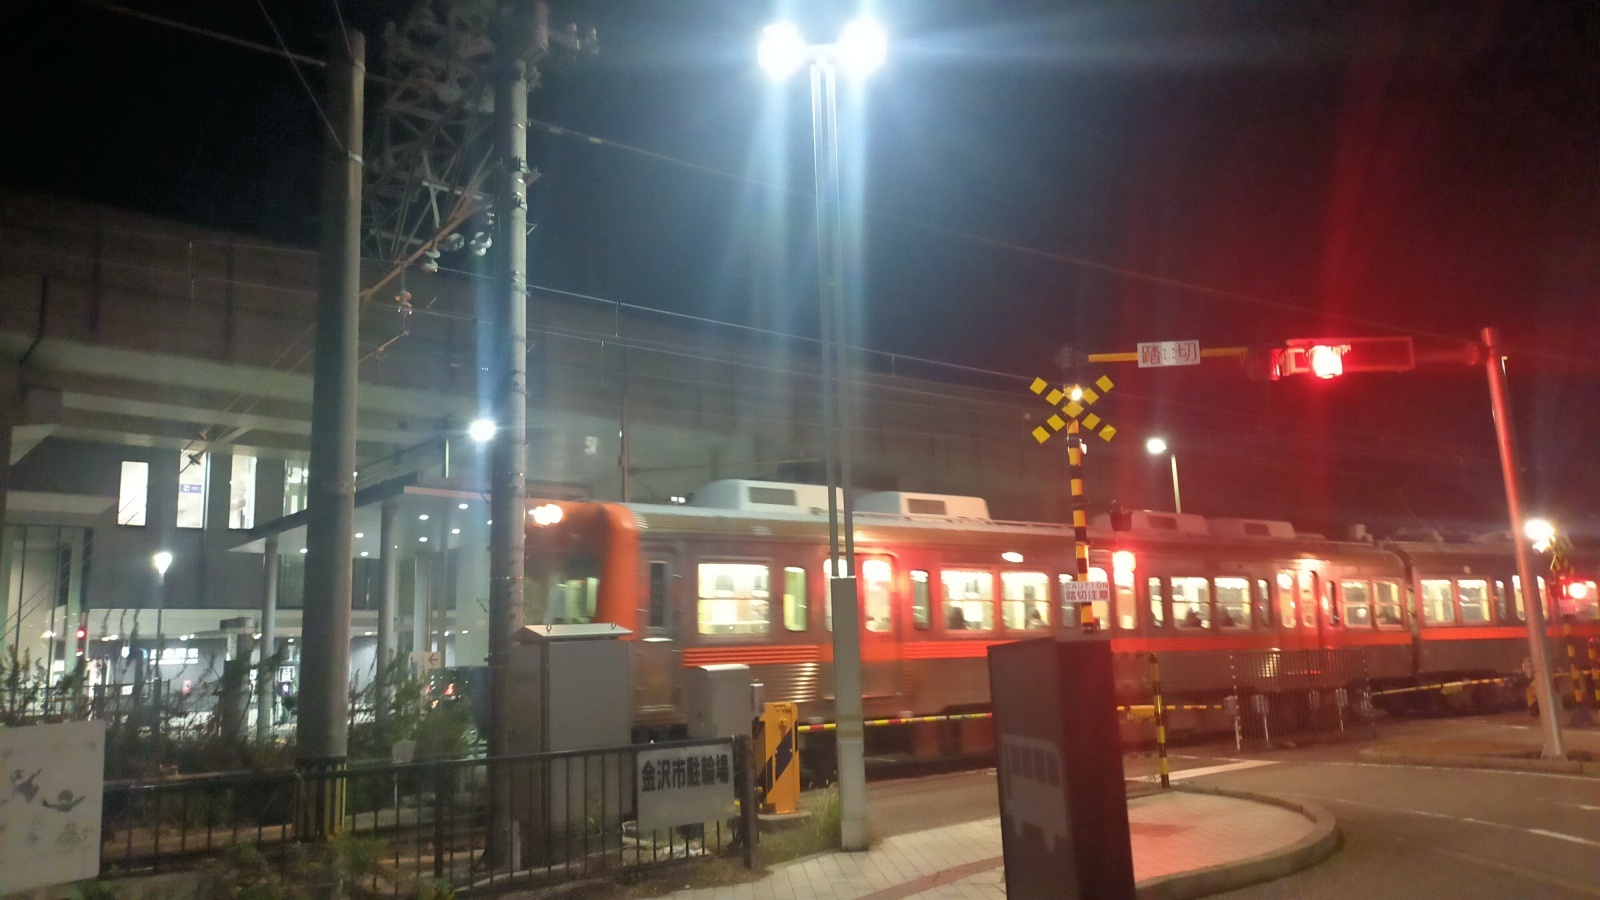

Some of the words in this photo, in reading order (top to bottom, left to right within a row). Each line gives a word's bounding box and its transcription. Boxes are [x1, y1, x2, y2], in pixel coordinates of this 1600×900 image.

[1141, 342, 1197, 364] 踏切
[1065, 582, 1109, 590] CAUTION
[641, 754, 729, 792] 金沢市駐輪場
